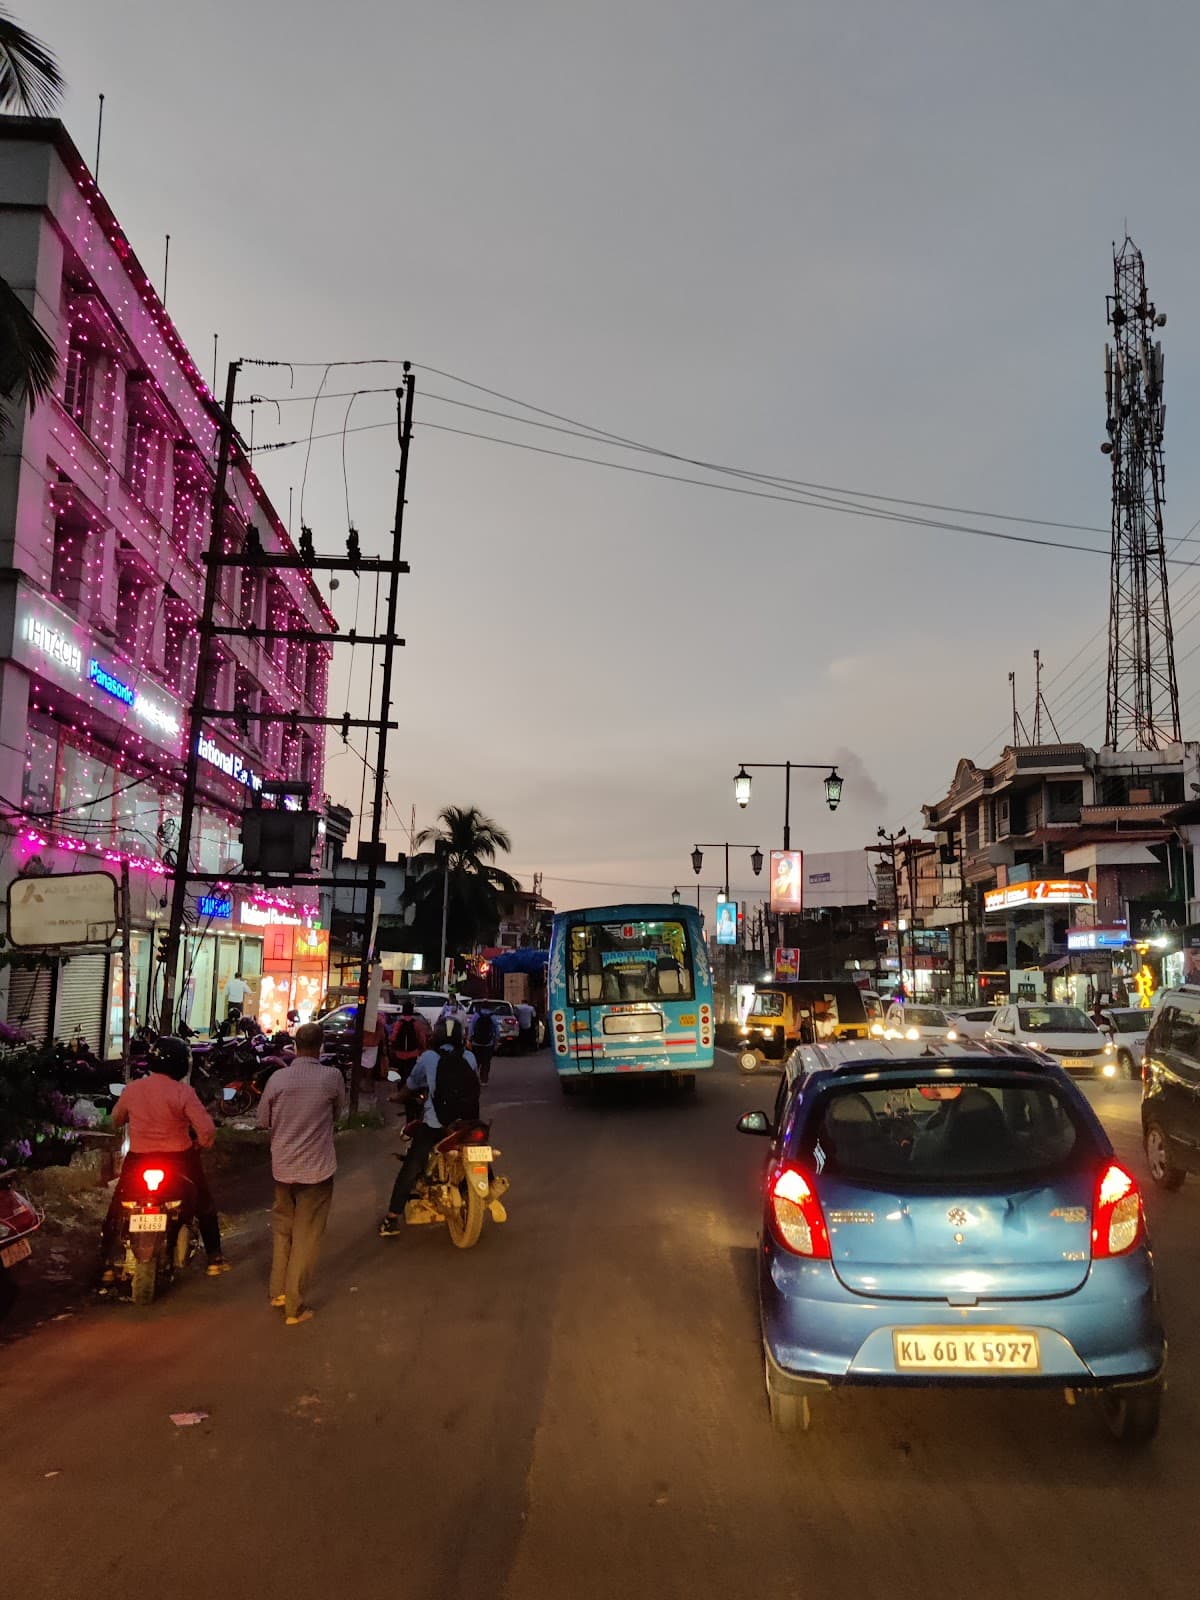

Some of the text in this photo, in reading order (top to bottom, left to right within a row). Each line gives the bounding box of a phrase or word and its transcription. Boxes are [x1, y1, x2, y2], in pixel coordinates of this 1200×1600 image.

[88, 657, 135, 707] Panasonic
[1140, 918, 1183, 930] ZARA
[901, 1341, 1032, 1363] KL 60 K 5977
